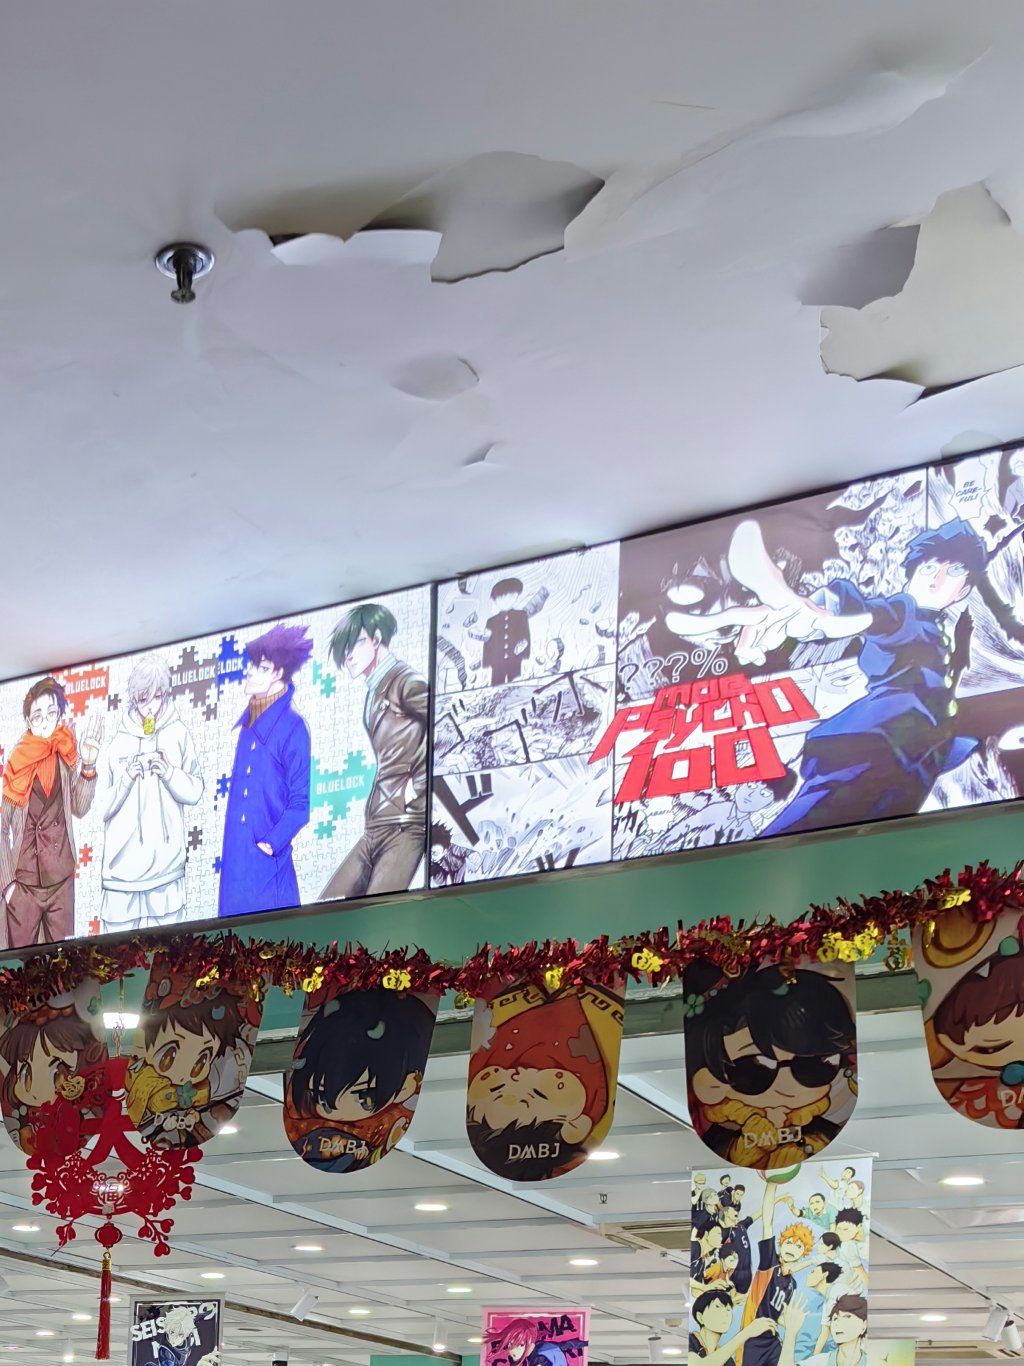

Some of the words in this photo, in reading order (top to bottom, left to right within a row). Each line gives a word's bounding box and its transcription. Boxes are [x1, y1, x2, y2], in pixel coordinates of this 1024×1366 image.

[66, 675, 106, 695] BLUELOCK
[171, 665, 216, 687] BLUELOCK
[588, 677, 820, 765] PSYCHO
[614, 728, 786, 804] 100
[316, 774, 365, 795] BLUELOCK
[319, 1136, 366, 1154] DMBJ
[743, 1126, 803, 1150] DMBJ
[508, 1142, 560, 1160] DMBJ
[769, 1286, 786, 1313] 10
